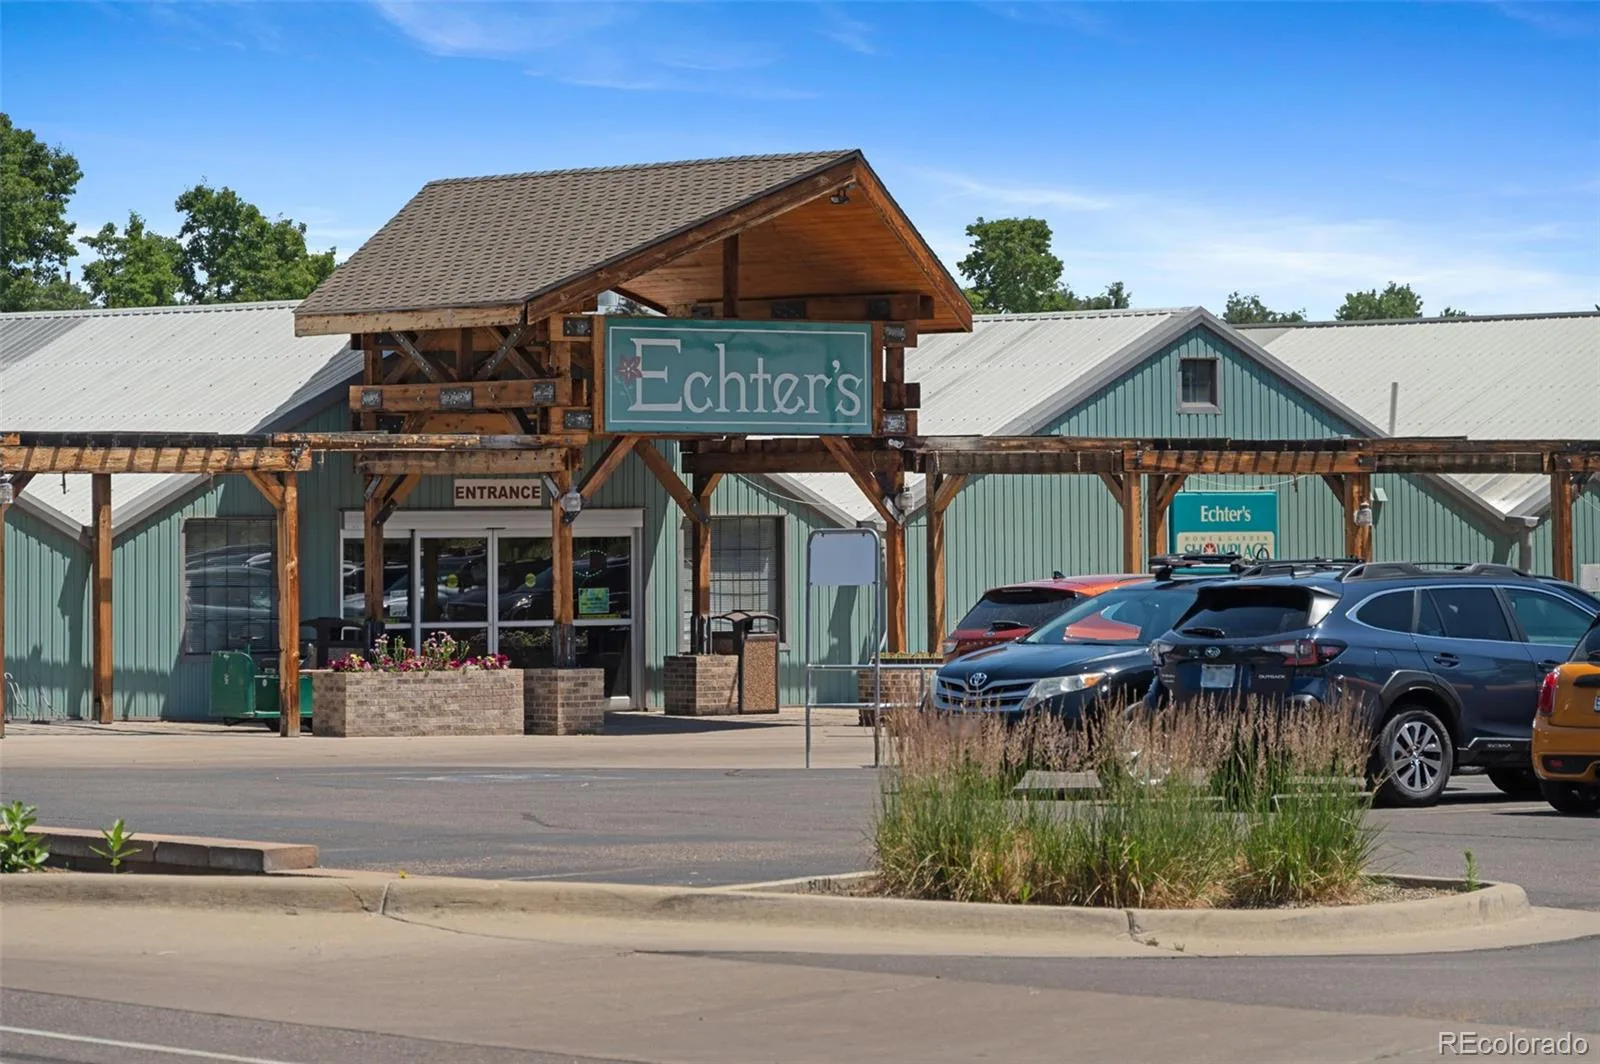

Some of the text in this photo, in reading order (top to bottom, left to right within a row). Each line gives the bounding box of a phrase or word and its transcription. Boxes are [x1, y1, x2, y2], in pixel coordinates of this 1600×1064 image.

[627, 338, 863, 416] Echter's
[455, 485, 541, 499] ENTRANCE
[1200, 505, 1252, 522] Echter's
